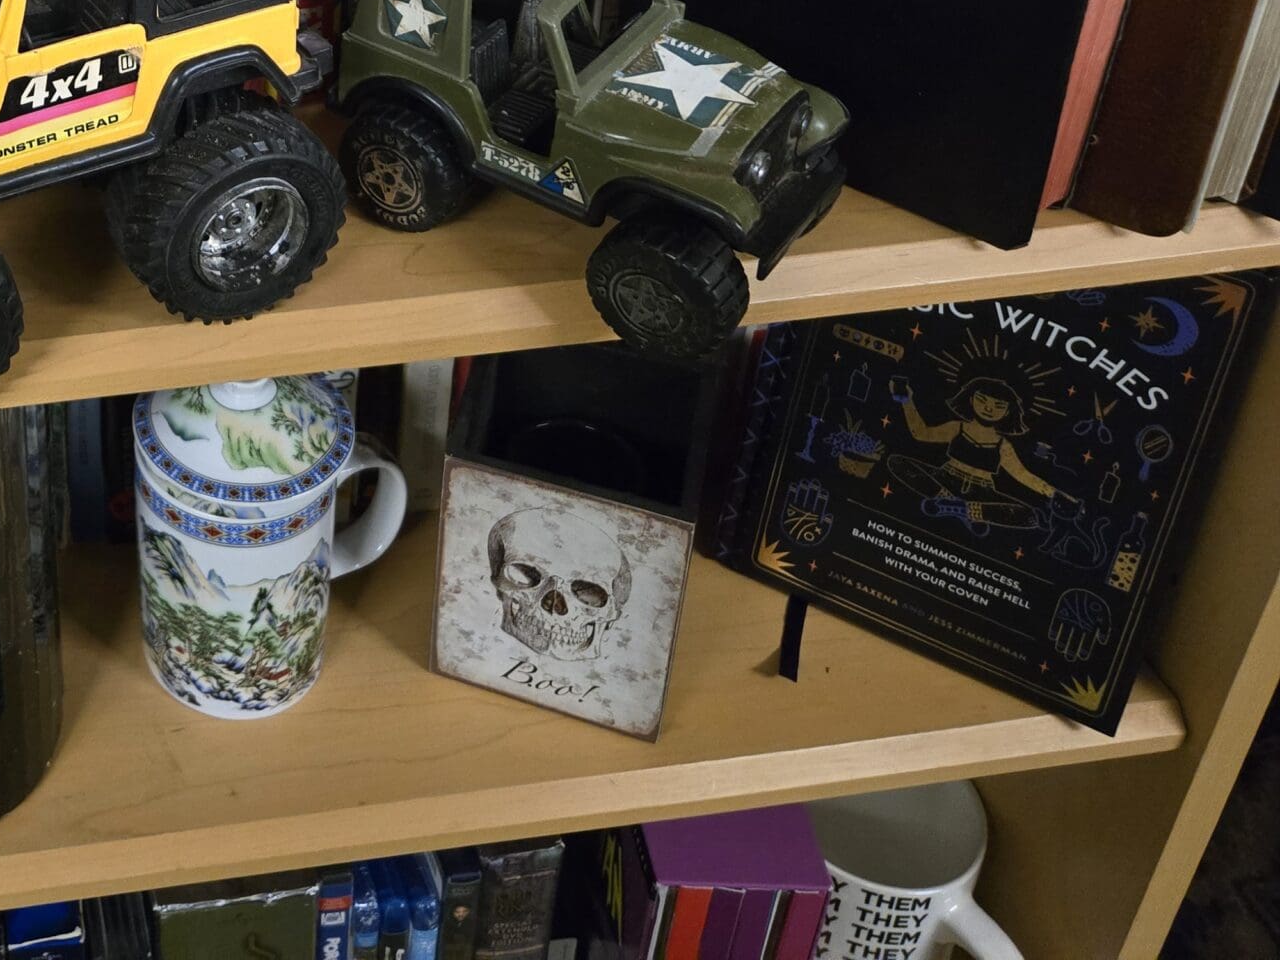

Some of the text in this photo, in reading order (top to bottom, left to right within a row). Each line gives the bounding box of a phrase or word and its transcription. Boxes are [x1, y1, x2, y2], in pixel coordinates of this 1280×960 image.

[19, 57, 103, 109] 4x4
[64, 114, 120, 138] TREAD
[994, 301, 1170, 411] WITCHES
[851, 527, 1032, 611] BANISH DRAMA, AND RAISE HELL
[867, 519, 1023, 592] HOW TO SUMMON SUCCESS,
[884, 555, 990, 607] WITH YOUR COVEN
[855, 581, 899, 607] SAXENA
[927, 614, 954, 632] JESS
[500, 655, 599, 703] Boo!
[856, 907, 928, 929] THEY
[861, 888, 932, 912] THEM
[846, 940, 917, 960] THEY
[851, 923, 921, 946] THEM
